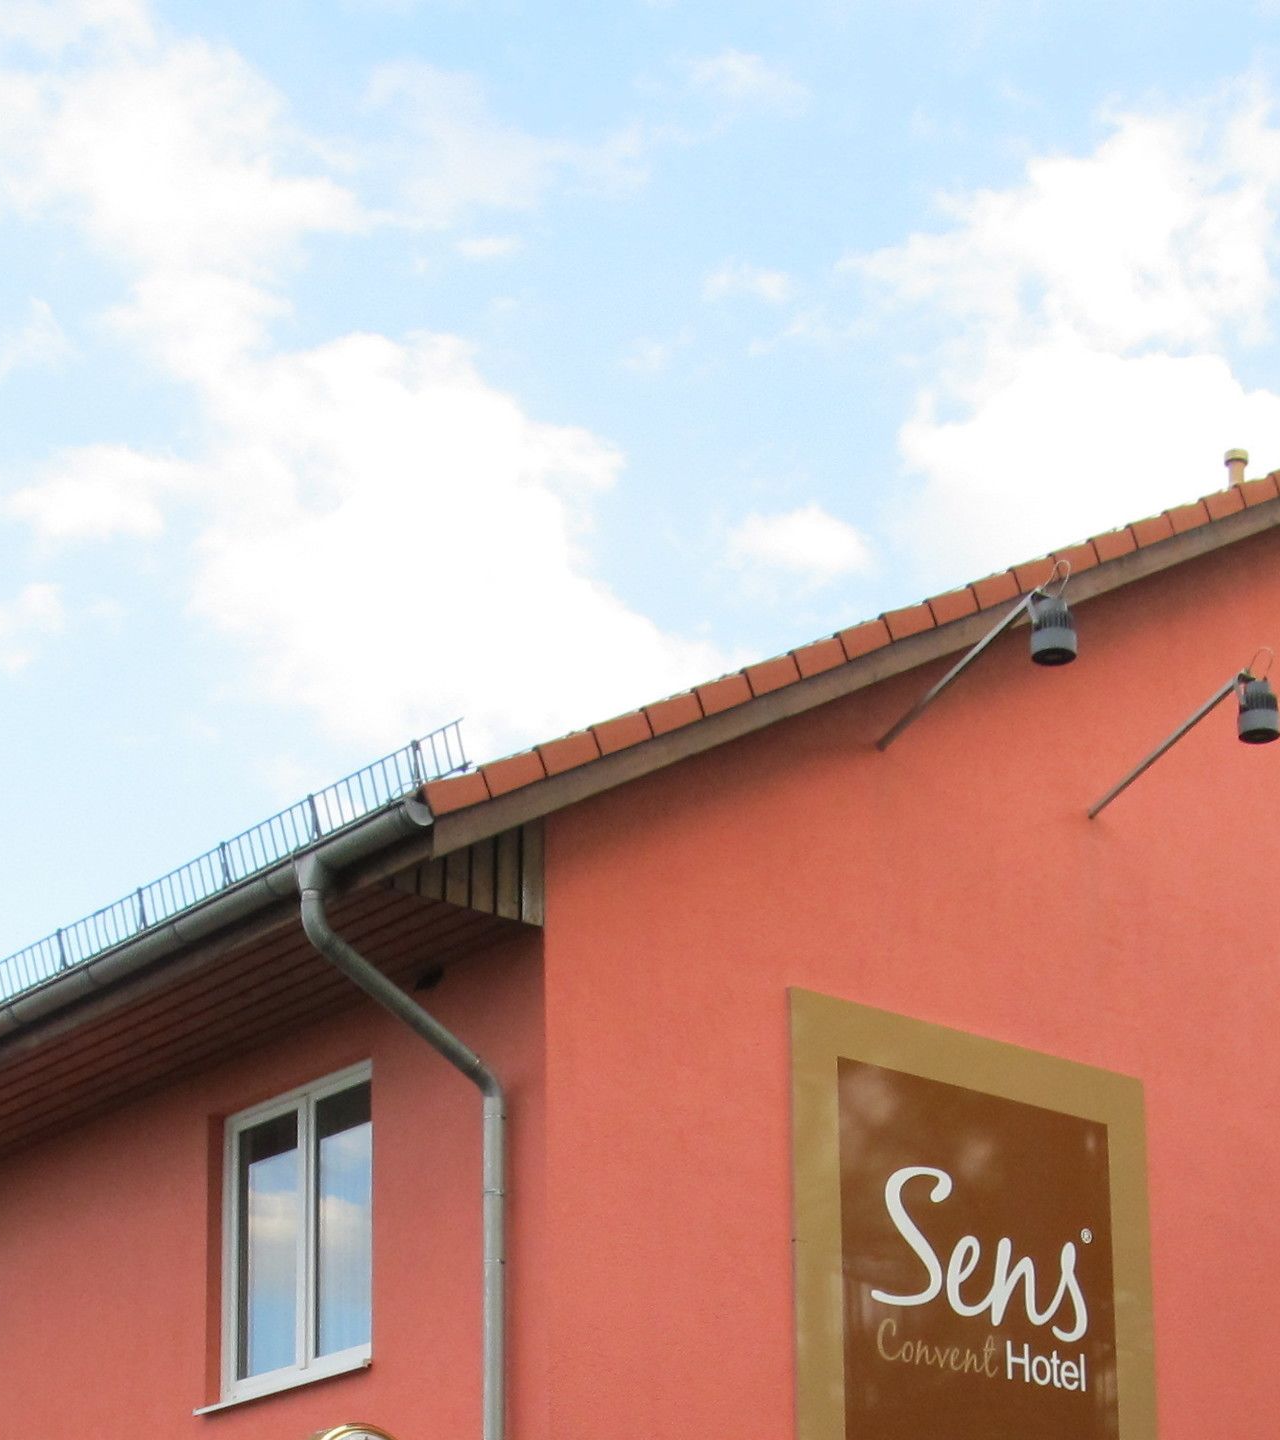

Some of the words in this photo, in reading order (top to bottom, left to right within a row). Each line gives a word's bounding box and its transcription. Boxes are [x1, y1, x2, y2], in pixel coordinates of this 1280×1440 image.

[871, 1166, 1088, 1342] Sens
[877, 1318, 999, 1378] Convent
[1006, 1340, 1086, 1392] Hotel
